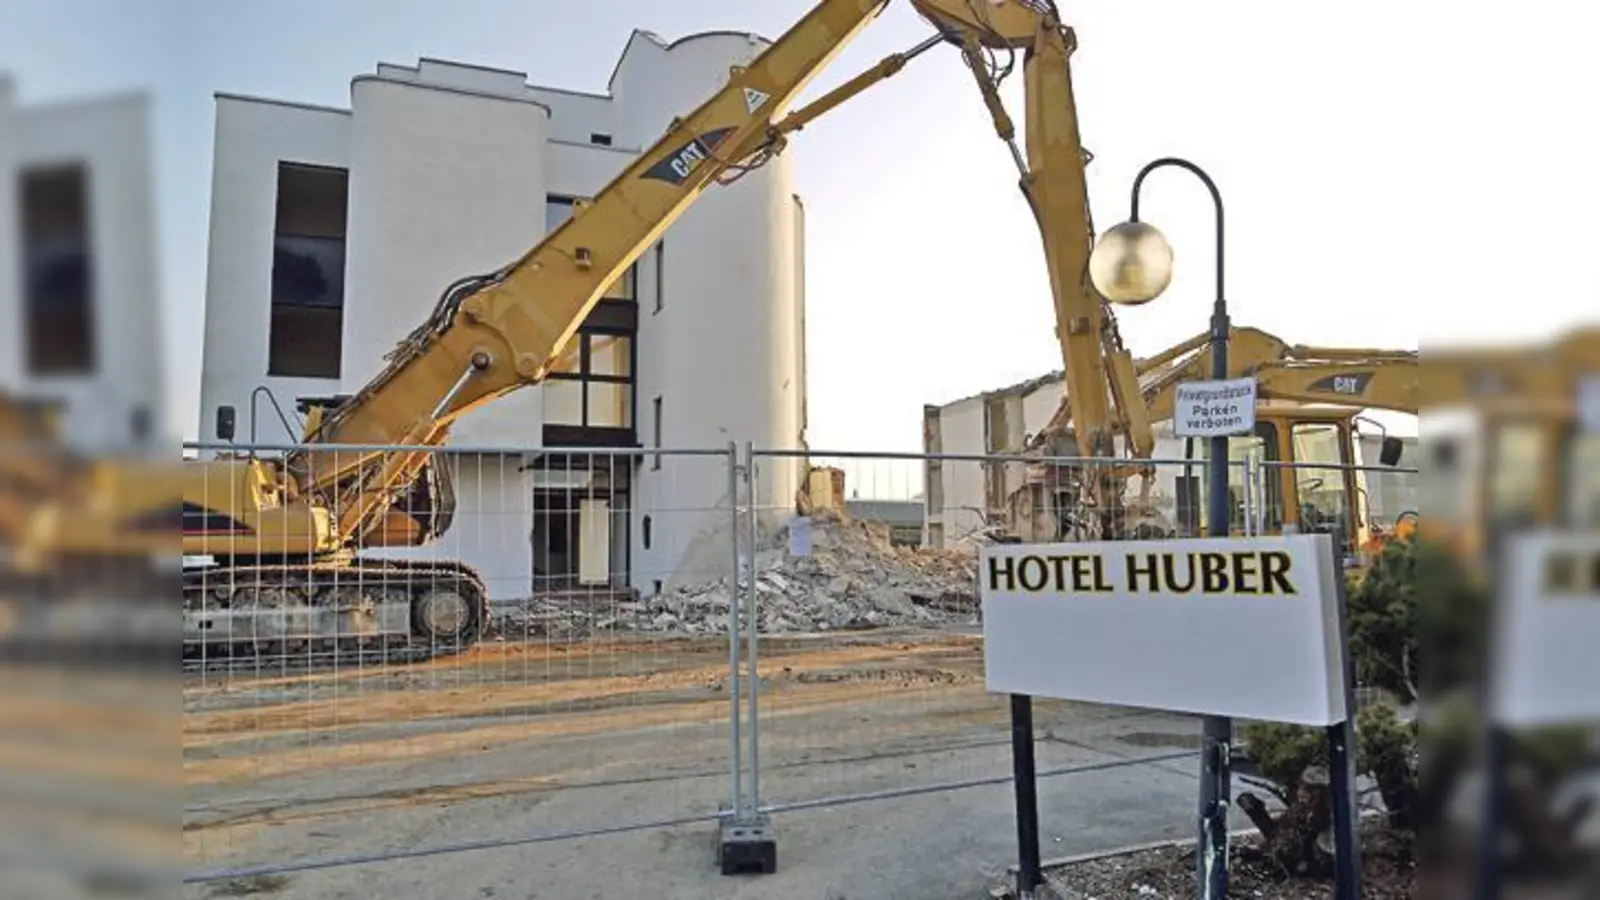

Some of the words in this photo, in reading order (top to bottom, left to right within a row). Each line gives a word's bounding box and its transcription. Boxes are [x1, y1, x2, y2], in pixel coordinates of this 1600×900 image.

[670, 142, 705, 177] CAT
[1333, 376, 1357, 393] CAT
[1192, 404, 1238, 416] Parken
[1187, 416, 1242, 428] verboten
[989, 555, 1114, 592] HOTEL
[1126, 551, 1298, 594] HUBER
